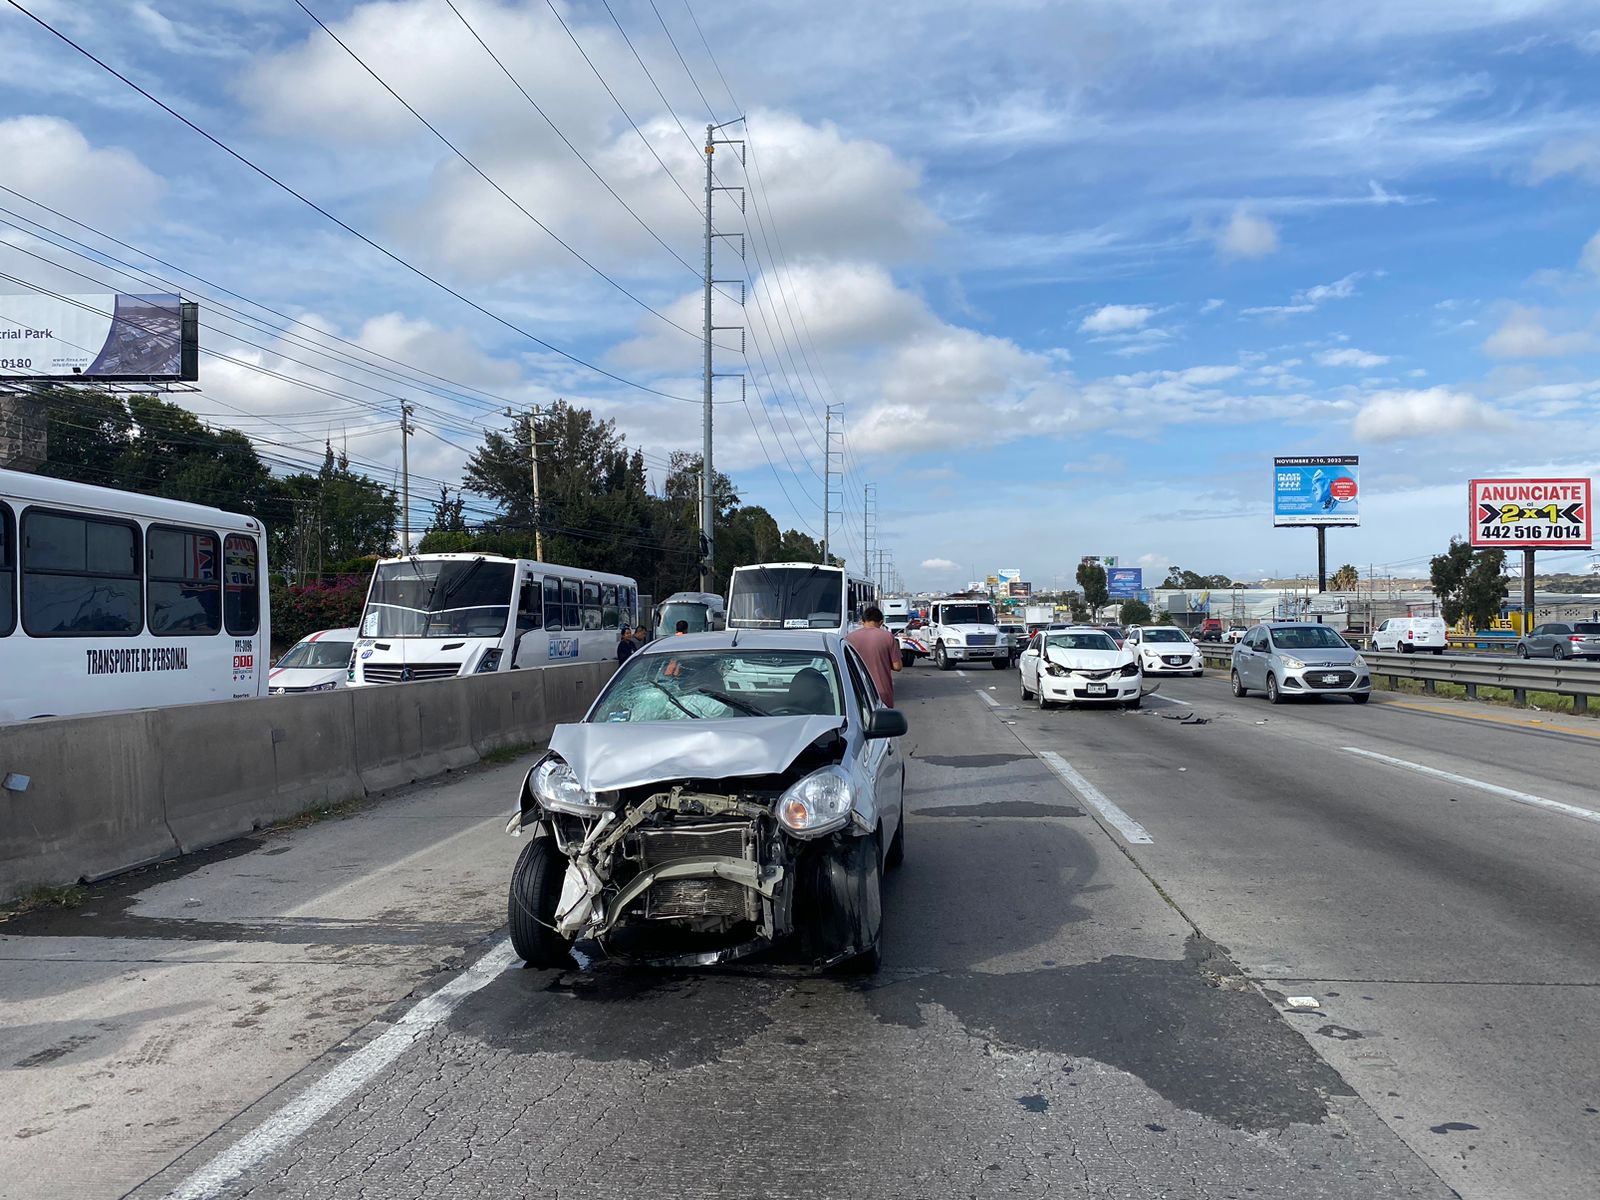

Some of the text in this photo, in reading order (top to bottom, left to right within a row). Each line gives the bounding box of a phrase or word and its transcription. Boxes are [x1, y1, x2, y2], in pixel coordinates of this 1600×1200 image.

[25, 328, 54, 339] Park
[1481, 486, 1581, 501] ANUNCIATE
[1482, 525, 1581, 539] 442 516 7014
[86, 647, 188, 675] TRANSPORTE DE PERSONAL
[234, 656, 252, 667] 911
